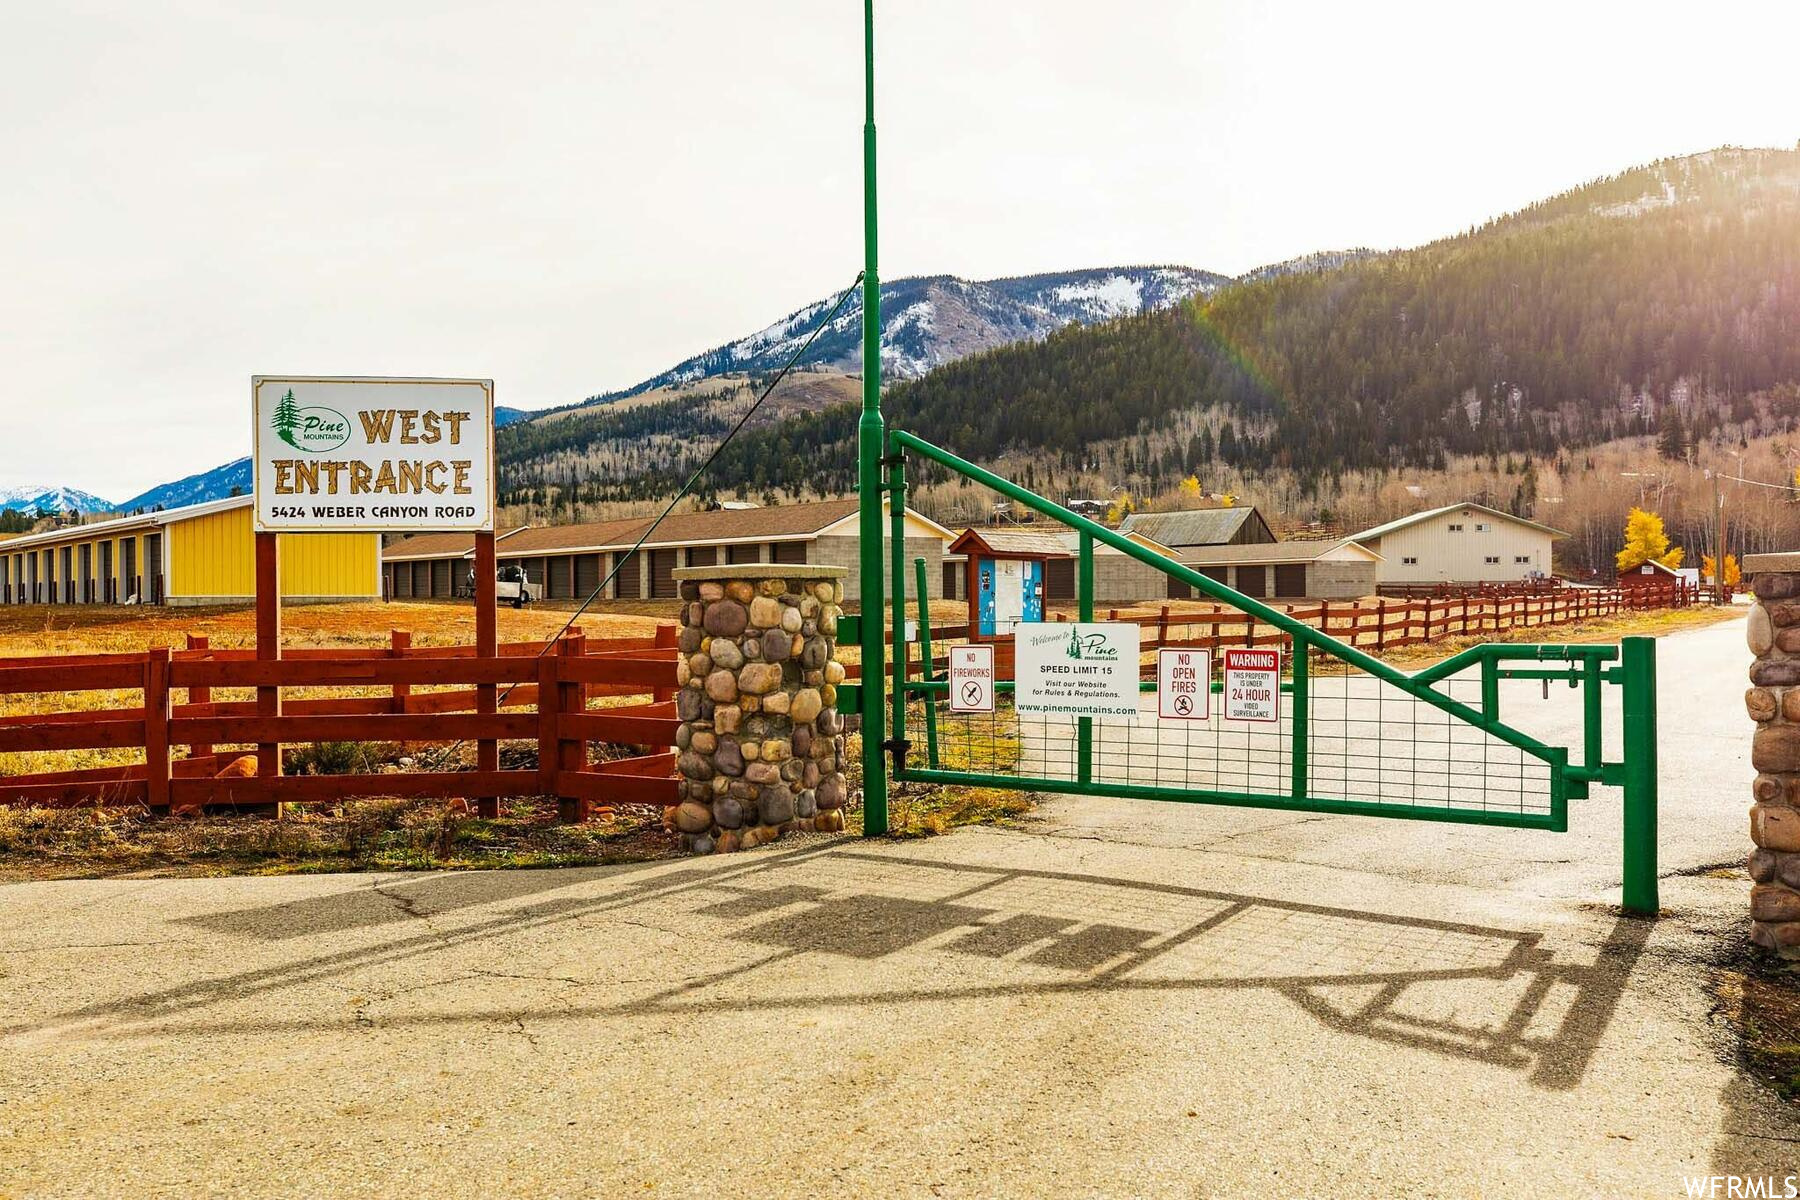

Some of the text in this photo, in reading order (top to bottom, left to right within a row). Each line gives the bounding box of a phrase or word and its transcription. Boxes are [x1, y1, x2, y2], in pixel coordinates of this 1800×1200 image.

[304, 416, 344, 433] Pine
[358, 409, 470, 444] WEST
[303, 433, 344, 441] MOUNTAINS
[271, 459, 472, 494] ENTRANCE
[271, 506, 476, 518] 5424 WEBER CANYON ROAD
[1082, 633, 1118, 653] Pine
[966, 653, 976, 663] NO
[1178, 653, 1190, 666] NO
[1229, 653, 1275, 667] WARNING
[953, 667, 990, 678] FIREWORKS
[1040, 665, 1113, 675] SPEED LIMIT 15
[1172, 667, 1196, 680] OPEN
[1233, 672, 1270, 680] THIS PROPERTY
[1078, 681, 1107, 689] Website
[1171, 681, 1196, 694] FIRES
[1246, 680, 1263, 688] UNDER
[1045, 689, 1065, 697] Rules
[1074, 690, 1121, 699] Regulations.
[1232, 688, 1271, 702] 24 HOUR
[1018, 704, 1137, 715] www.pinemountains.com
[1244, 702, 1259, 710] VIDEO
[1233, 710, 1269, 719] SURVEILLANCE
